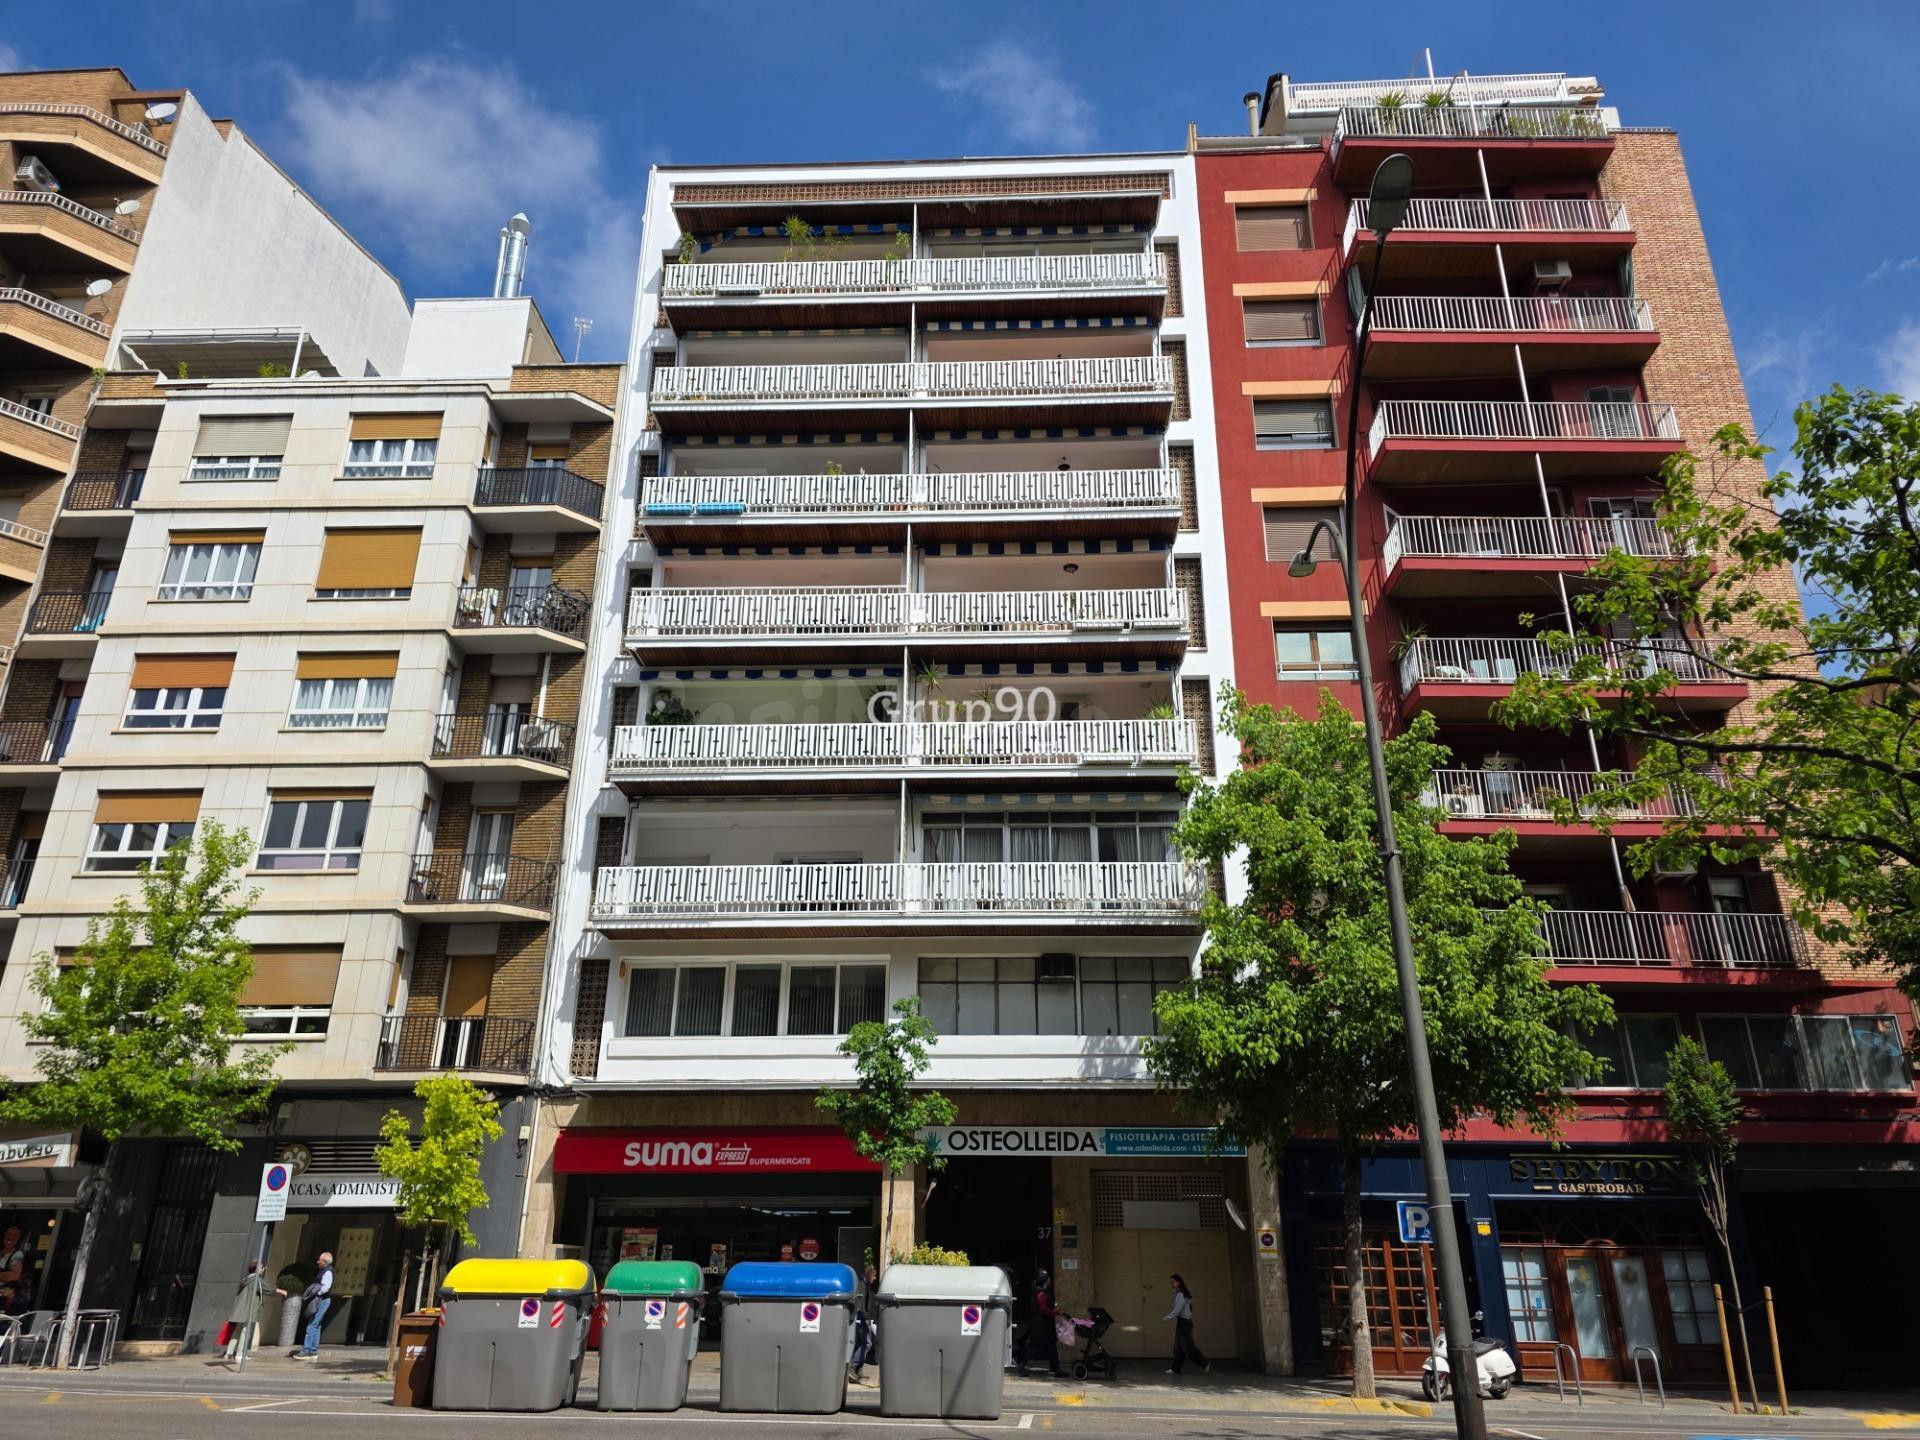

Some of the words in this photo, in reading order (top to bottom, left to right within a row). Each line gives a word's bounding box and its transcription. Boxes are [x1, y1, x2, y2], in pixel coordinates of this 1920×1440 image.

[948, 1130, 1098, 1152] OSTEOLLEIDA
[1110, 1131, 1174, 1142] FISIOTERÀPIA
[624, 1142, 713, 1166] suma
[749, 1157, 812, 1166] SUPERMERCATS
[1116, 1144, 1187, 1153] www.osteolleida.com
[287, 1182, 322, 1196] NCAS
[1558, 1183, 1645, 1194] GASTROBAR
[1405, 1206, 1430, 1238] P
[1037, 1227, 1052, 1240] 37
